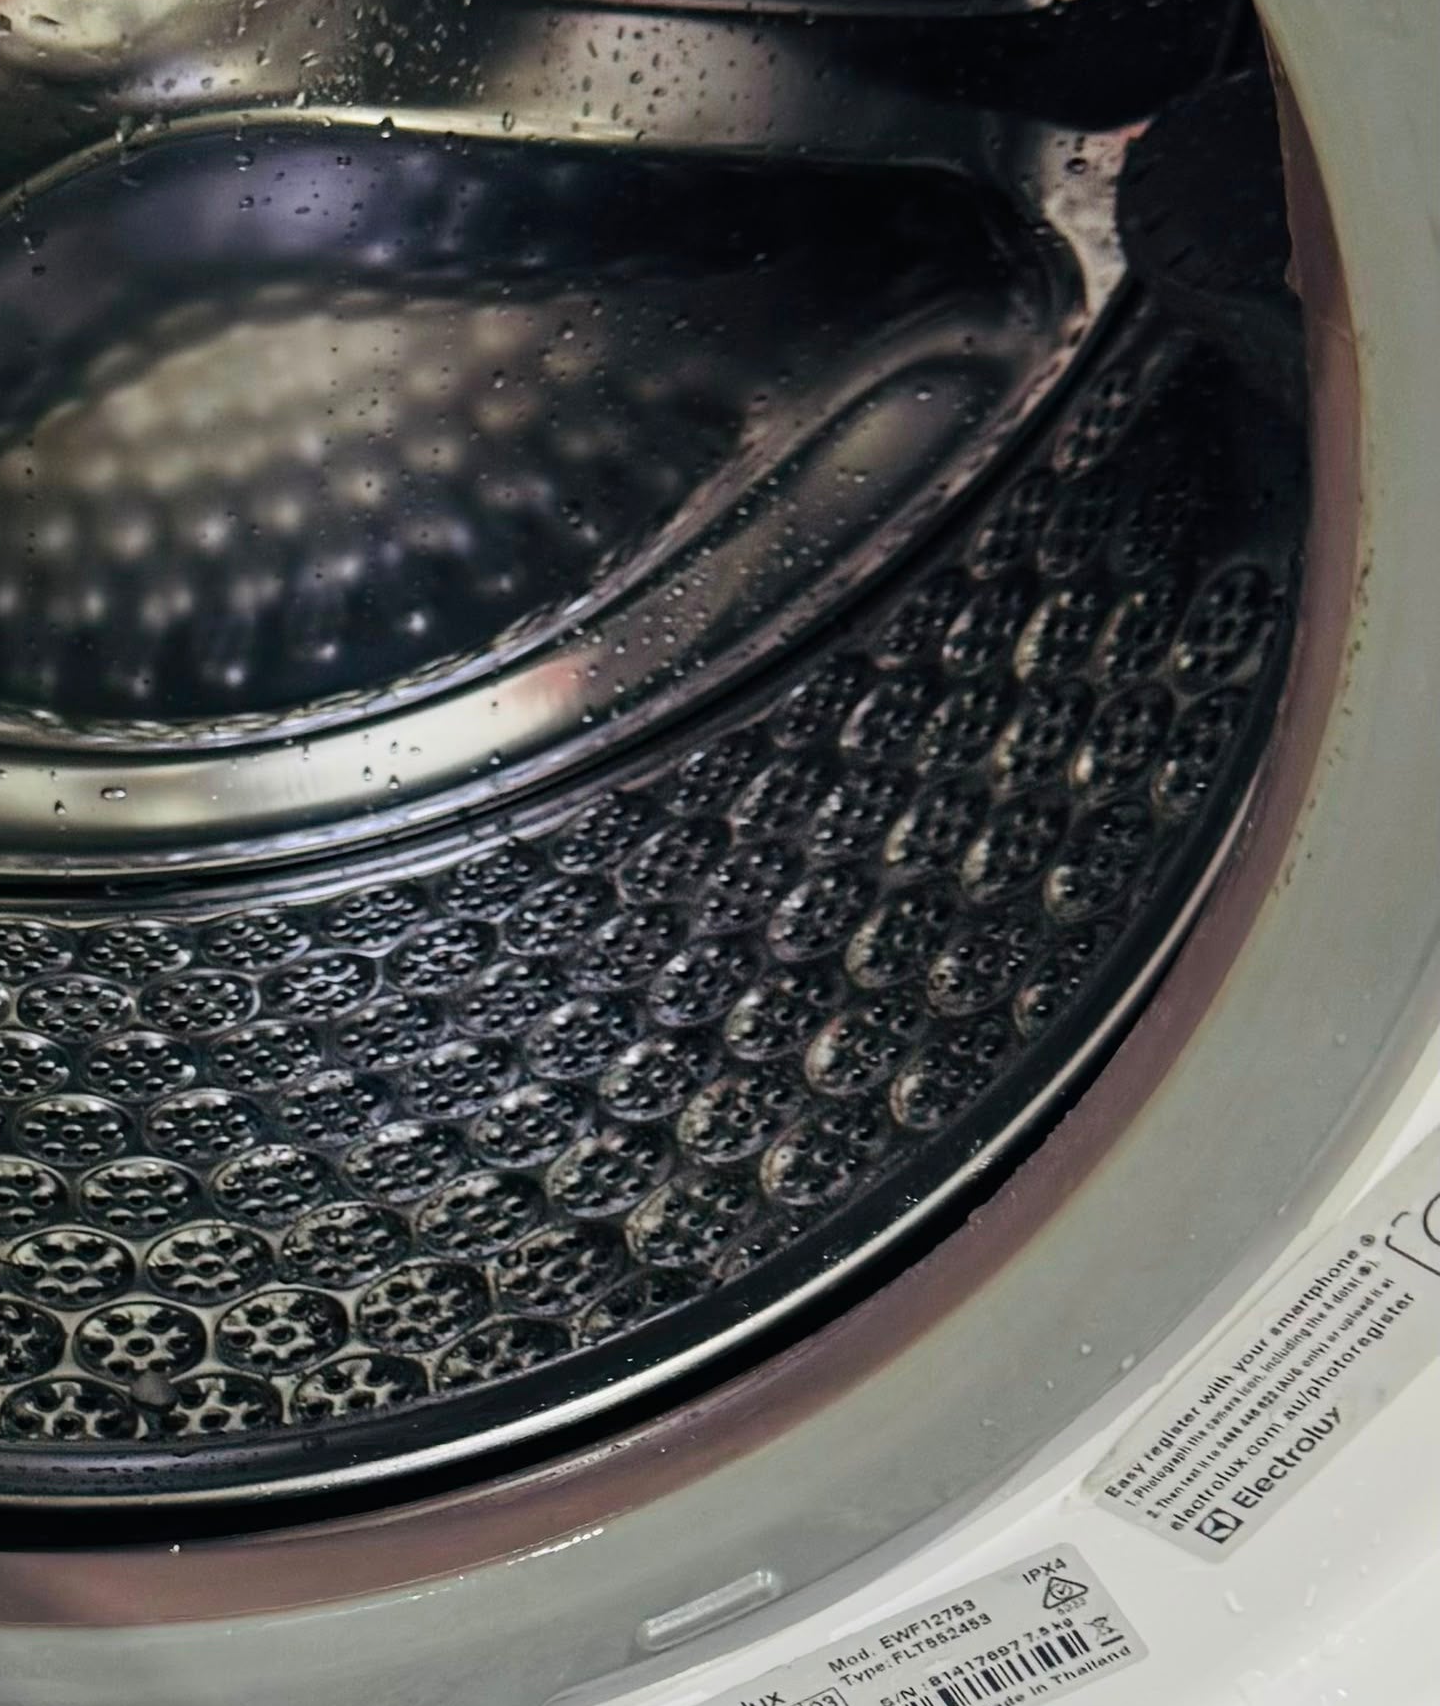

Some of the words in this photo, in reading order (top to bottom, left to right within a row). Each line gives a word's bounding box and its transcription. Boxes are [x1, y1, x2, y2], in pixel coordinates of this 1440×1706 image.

[1232, 1339, 1269, 1373] your
[1269, 1250, 1359, 1337] smartphone
[1231, 1405, 1342, 1509] Electrolux
[1022, 1557, 1067, 1585] IPX4
[827, 1647, 877, 1674] Mod.
[879, 1598, 977, 1649] EWF12753
[1050, 1645, 1132, 1684] Thailand
